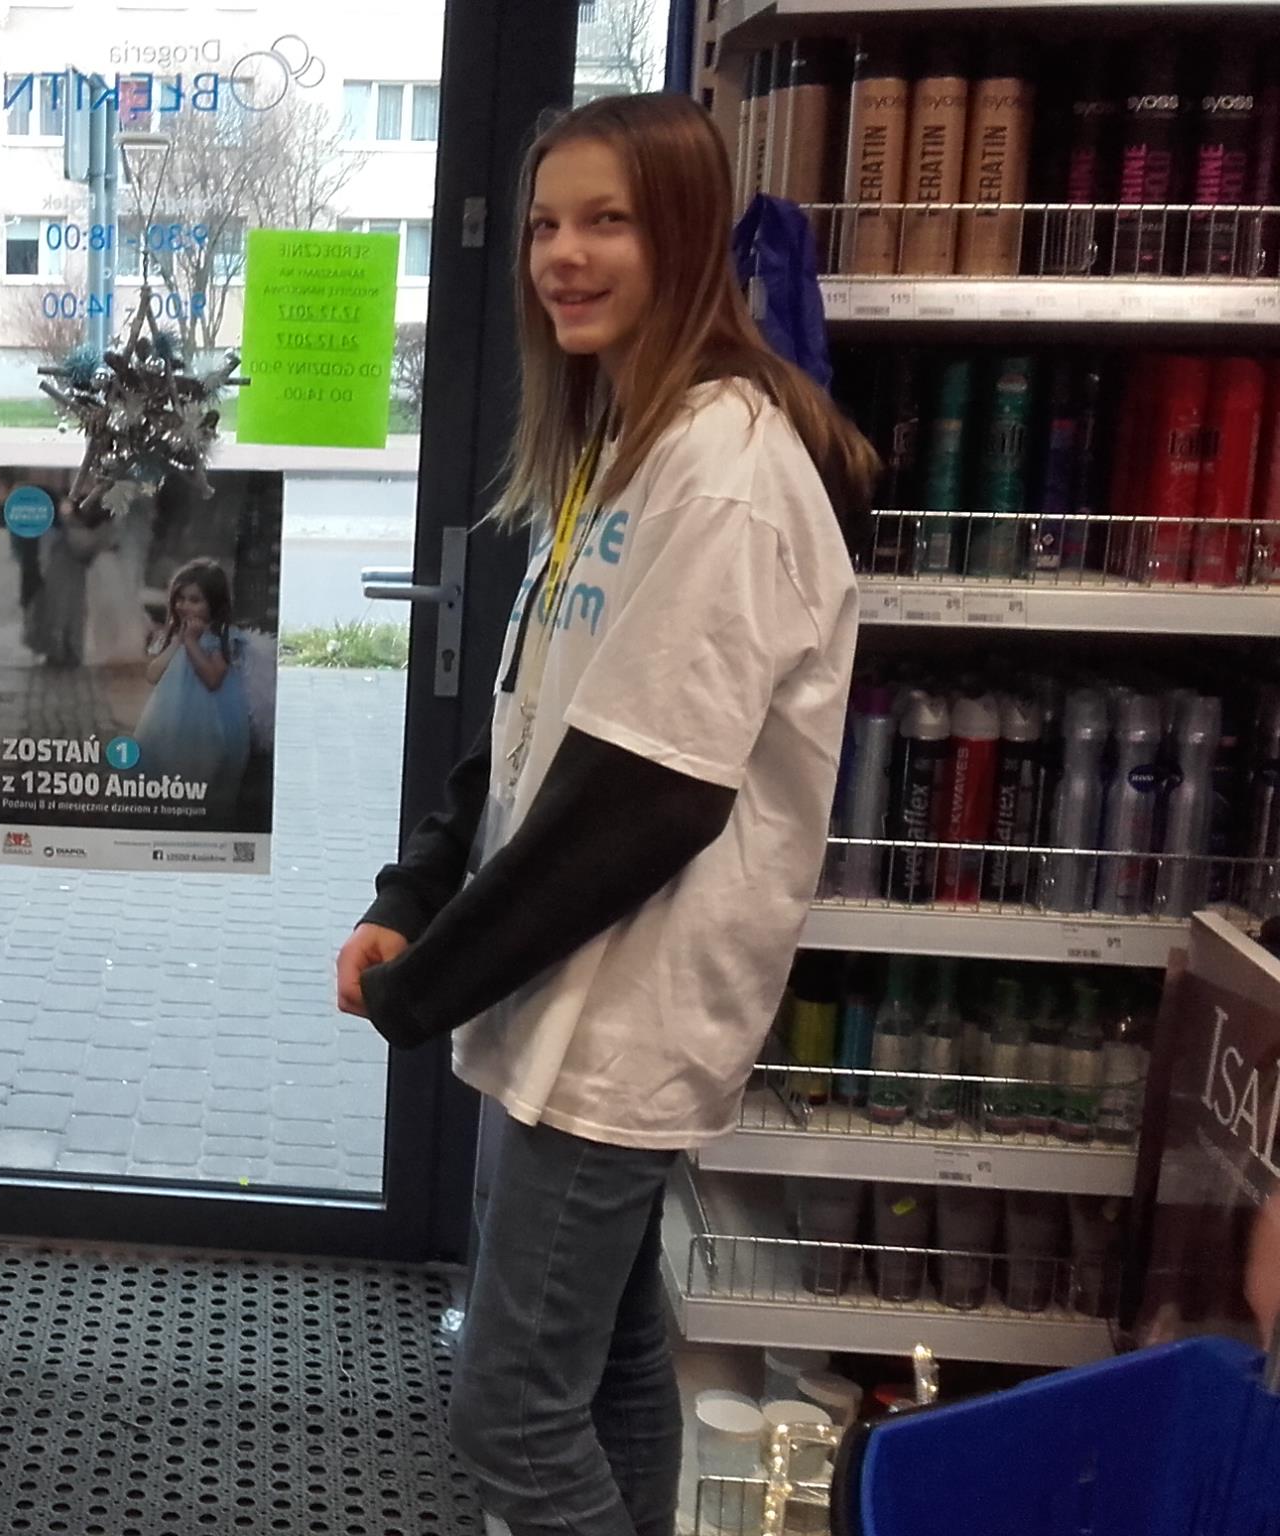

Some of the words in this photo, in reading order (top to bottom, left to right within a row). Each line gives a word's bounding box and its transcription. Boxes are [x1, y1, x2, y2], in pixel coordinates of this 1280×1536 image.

[2, 734, 100, 763] ZOSTAŃ
[115, 742, 128, 763] 1
[2, 775, 15, 793] z
[21, 770, 100, 796] 12500
[105, 773, 208, 800] Aniołów
[2, 798, 37, 812] Podaruj
[111, 802, 151, 814] dzieciom
